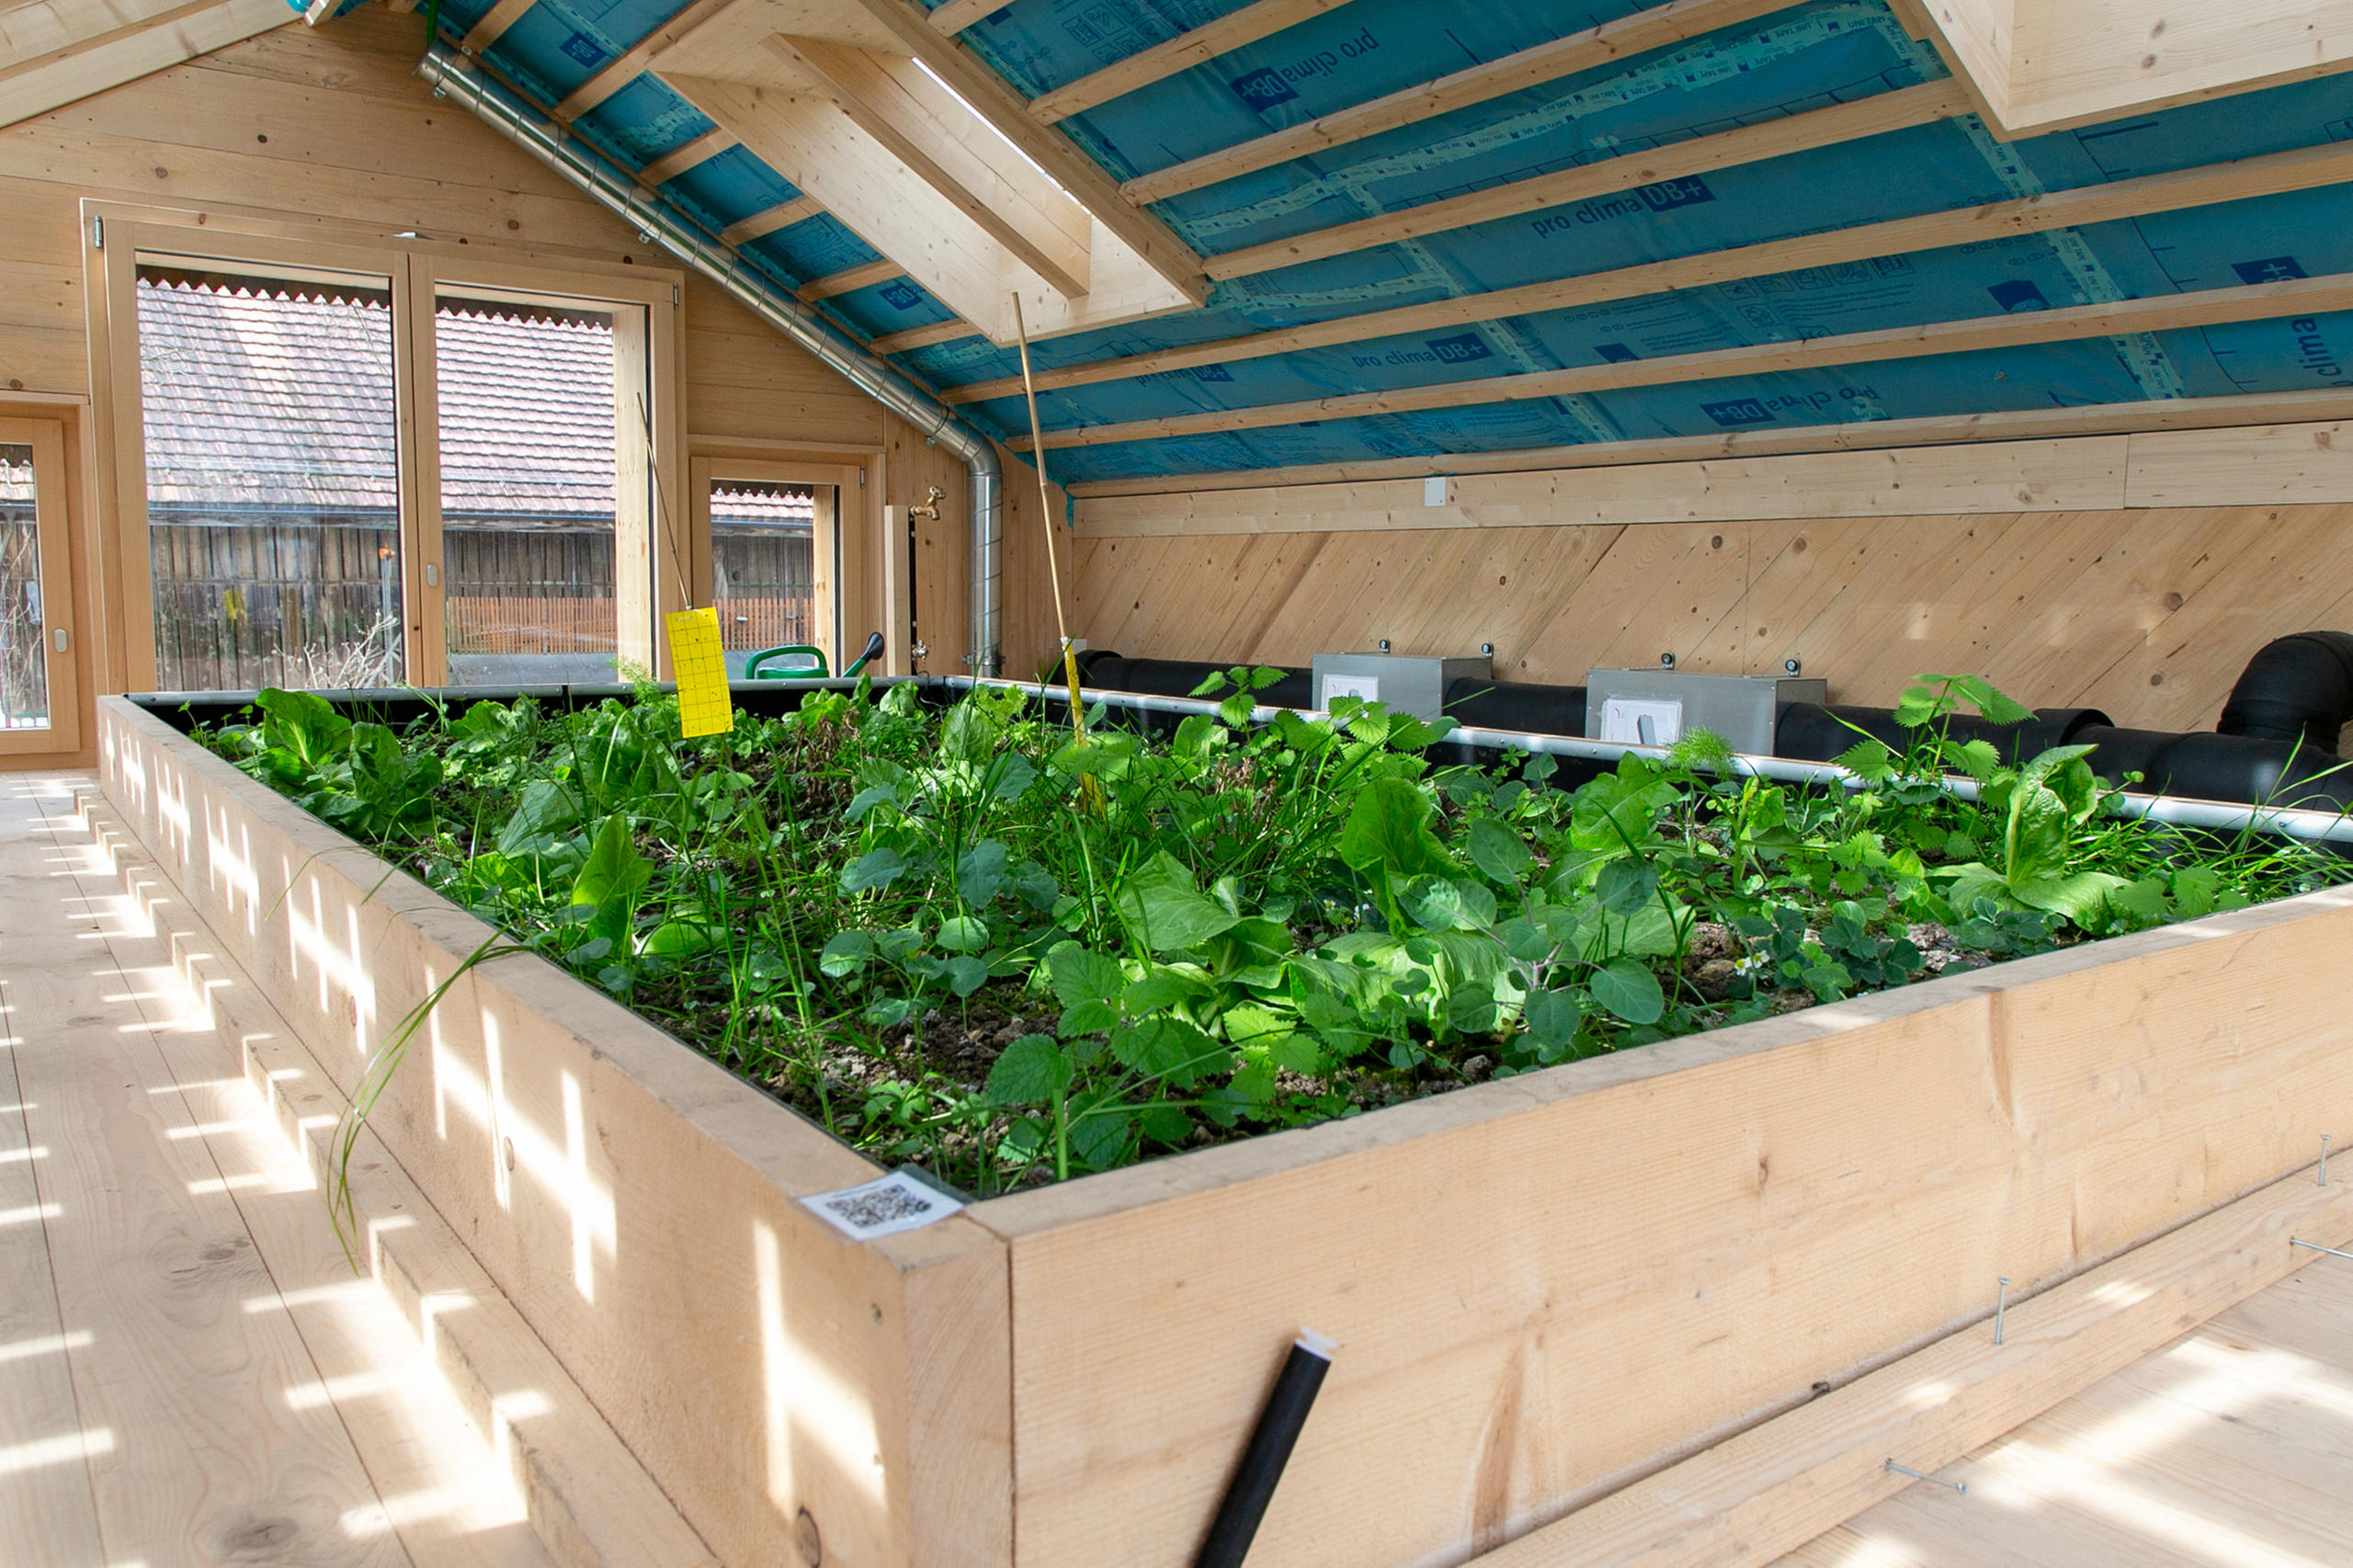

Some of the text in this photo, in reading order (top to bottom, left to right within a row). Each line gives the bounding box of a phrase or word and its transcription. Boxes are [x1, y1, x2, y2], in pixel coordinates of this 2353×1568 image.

[1241, 26, 1381, 98] pro clima DB+
[1529, 181, 1701, 240] pro clima DB+
[1350, 343, 1483, 369] pro clima DB+
[2290, 316, 2343, 377] clima
[1712, 383, 1883, 421] pro clima DB+
